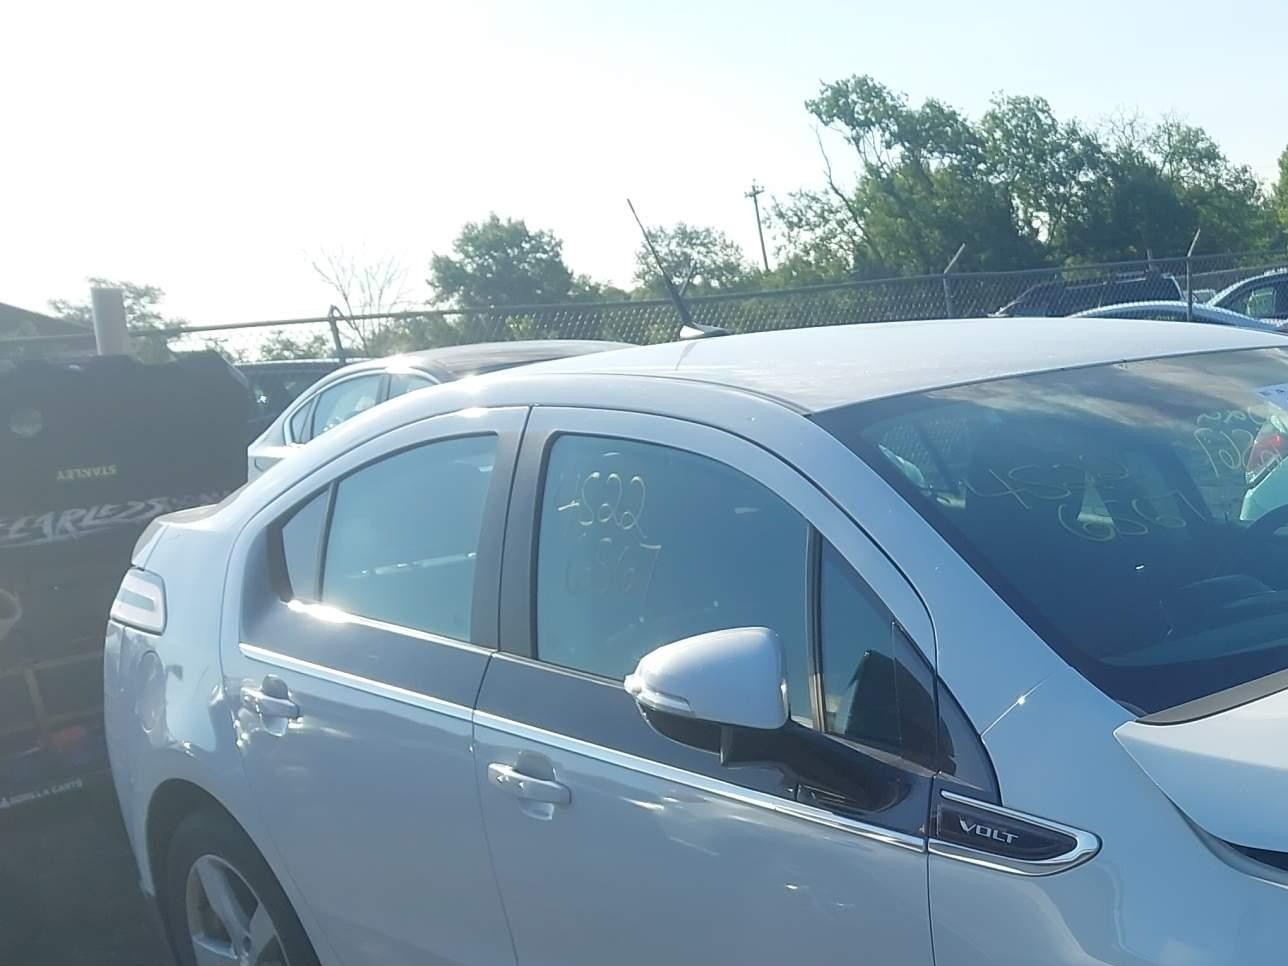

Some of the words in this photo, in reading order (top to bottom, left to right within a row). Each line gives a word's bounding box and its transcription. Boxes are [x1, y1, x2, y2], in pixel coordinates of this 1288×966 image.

[57, 465, 117, 480] STANLEY
[0, 498, 166, 543] EARLESS
[959, 817, 1019, 844] VOLT
